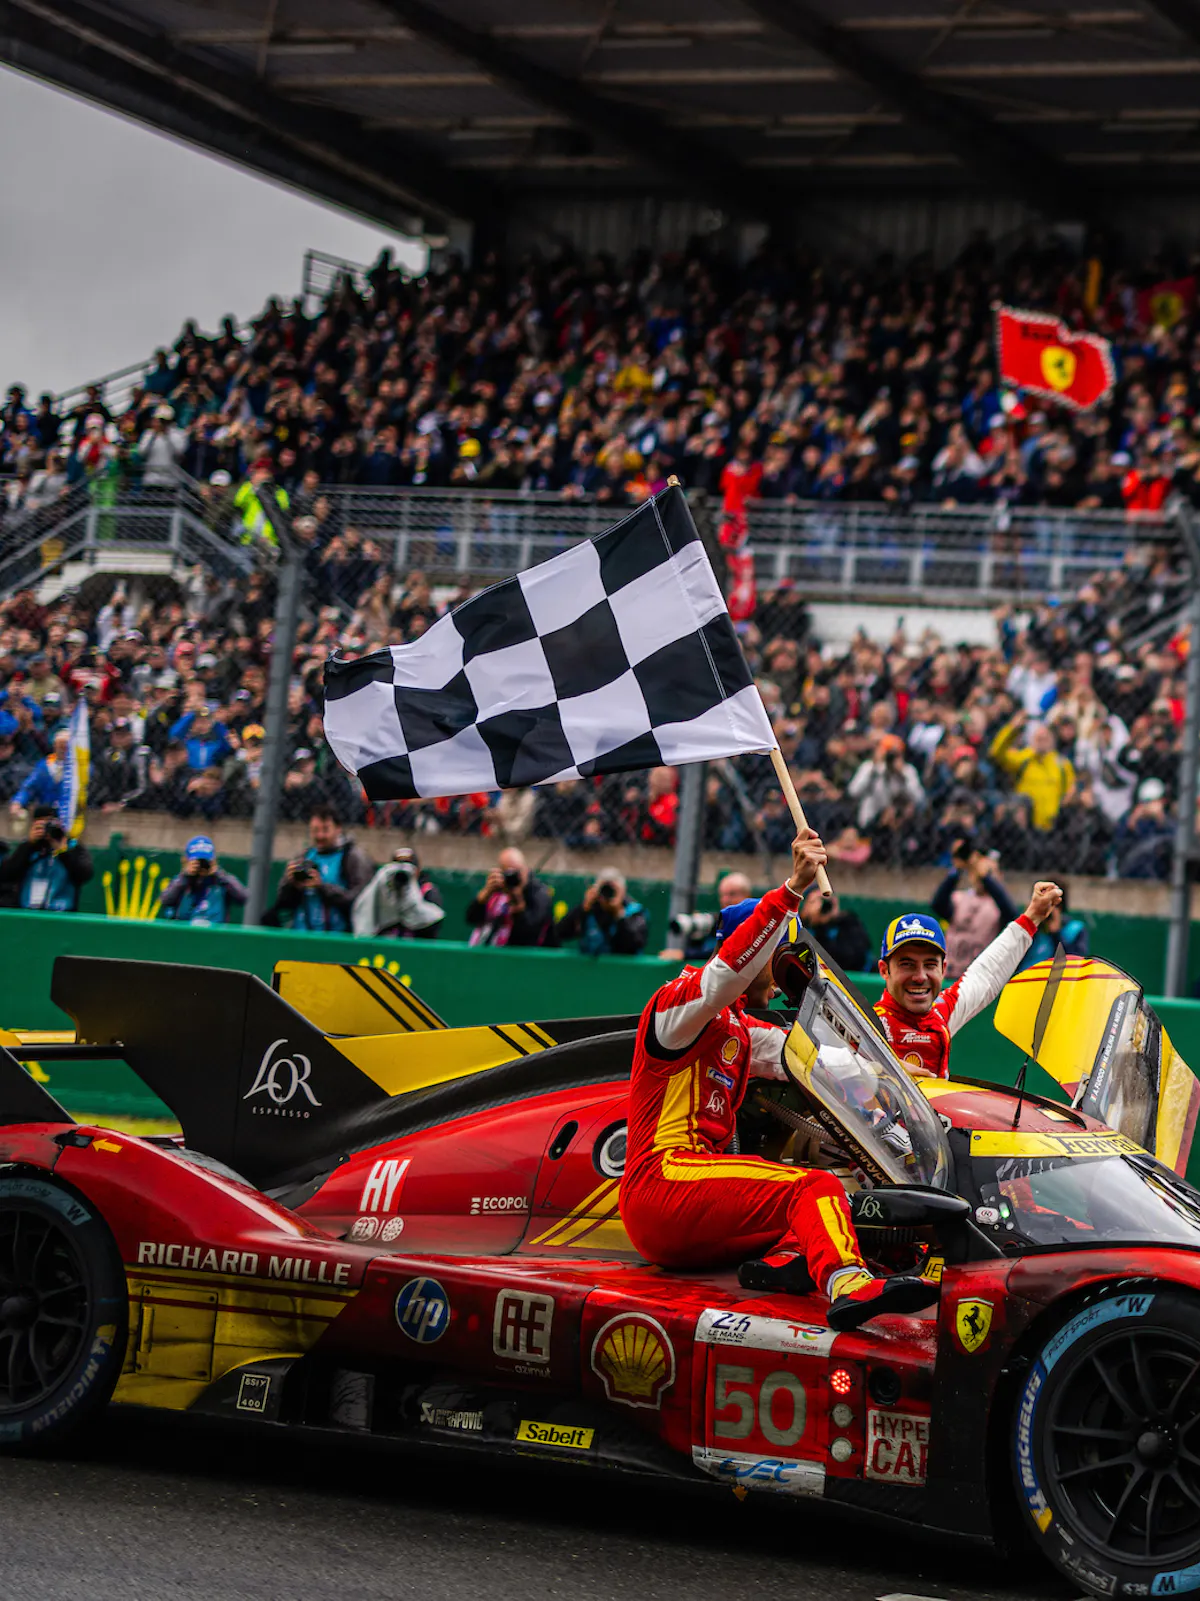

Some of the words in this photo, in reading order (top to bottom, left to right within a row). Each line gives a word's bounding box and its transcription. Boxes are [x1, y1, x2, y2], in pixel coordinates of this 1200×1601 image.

[895, 930, 935, 941] MICHELIN
[252, 1106, 310, 1119] ESPRESSO
[359, 1159, 411, 1212] HY
[482, 1197, 529, 1210] ECOPOL
[138, 1242, 258, 1276] RICHARD
[268, 1255, 352, 1285] MILLE
[402, 1278, 445, 1341] hp
[1128, 1297, 1146, 1312] W
[708, 1329, 719, 1337] LE
[1072, 1310, 1100, 1333] SPORT
[32, 1357, 99, 1433] MICHELIN
[241, 1399, 261, 1408] 400
[714, 1364, 806, 1446] 50
[526, 1423, 585, 1445] Sabelt
[873, 1414, 930, 1441] HYPE
[1017, 1371, 1042, 1488] MICHELIN
